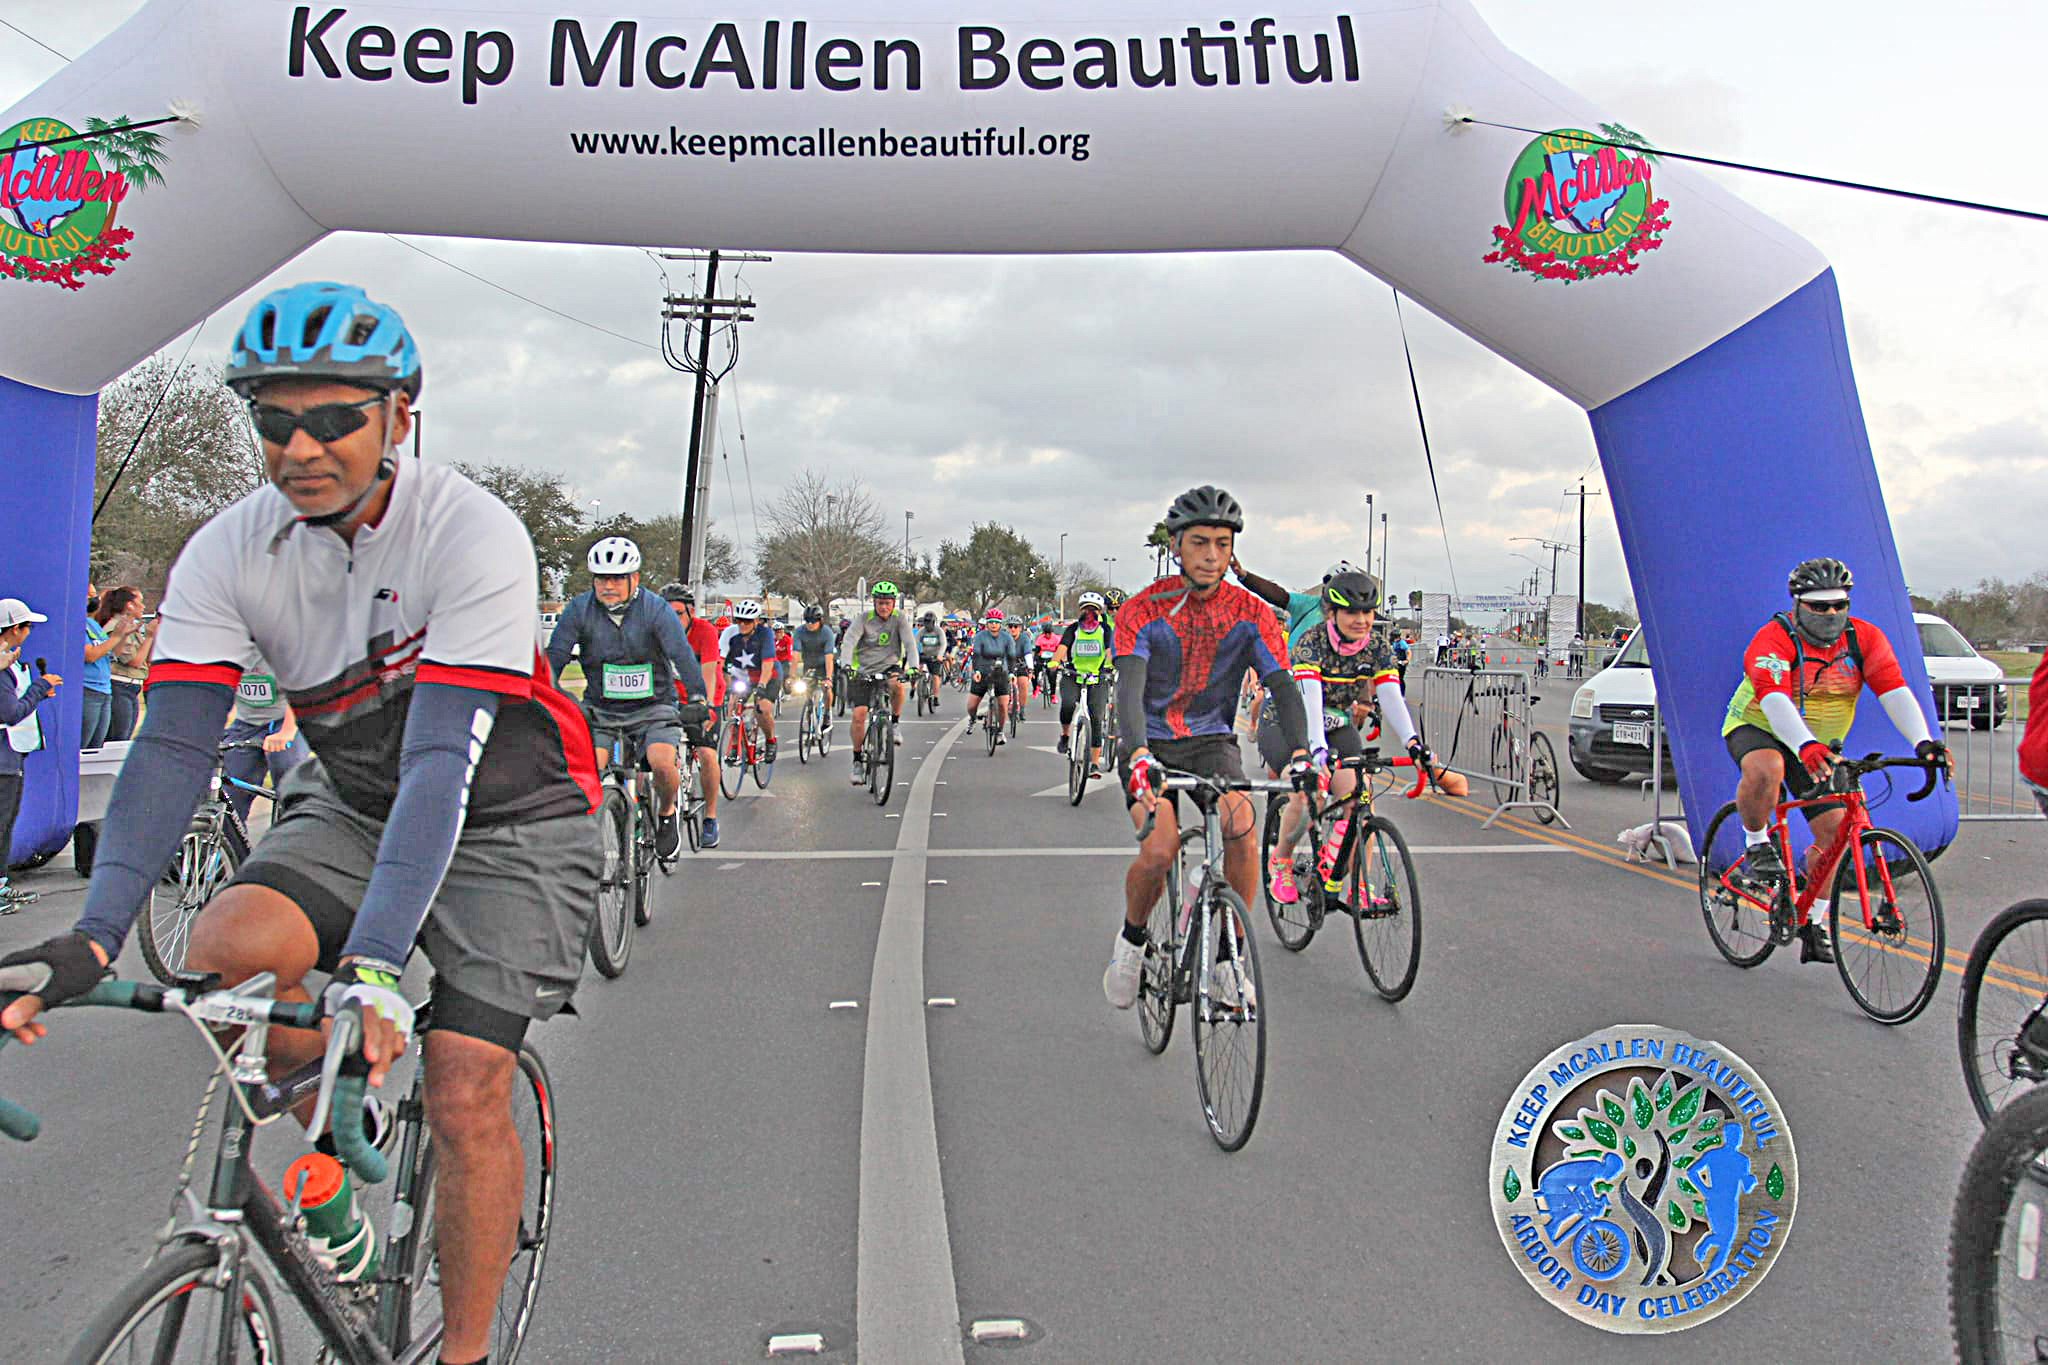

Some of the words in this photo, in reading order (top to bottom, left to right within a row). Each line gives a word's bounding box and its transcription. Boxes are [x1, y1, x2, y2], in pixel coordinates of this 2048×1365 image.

[288, 6, 515, 105] Keep
[549, 19, 921, 91] McAllen
[957, 15, 1360, 91] Beautiful
[570, 126, 1090, 162] www.keepmcallenbeautiful.org
[1541, 132, 1594, 155] KEEP
[1526, 211, 1642, 256] BEAUTIFUL
[618, 674, 645, 687] 1067
